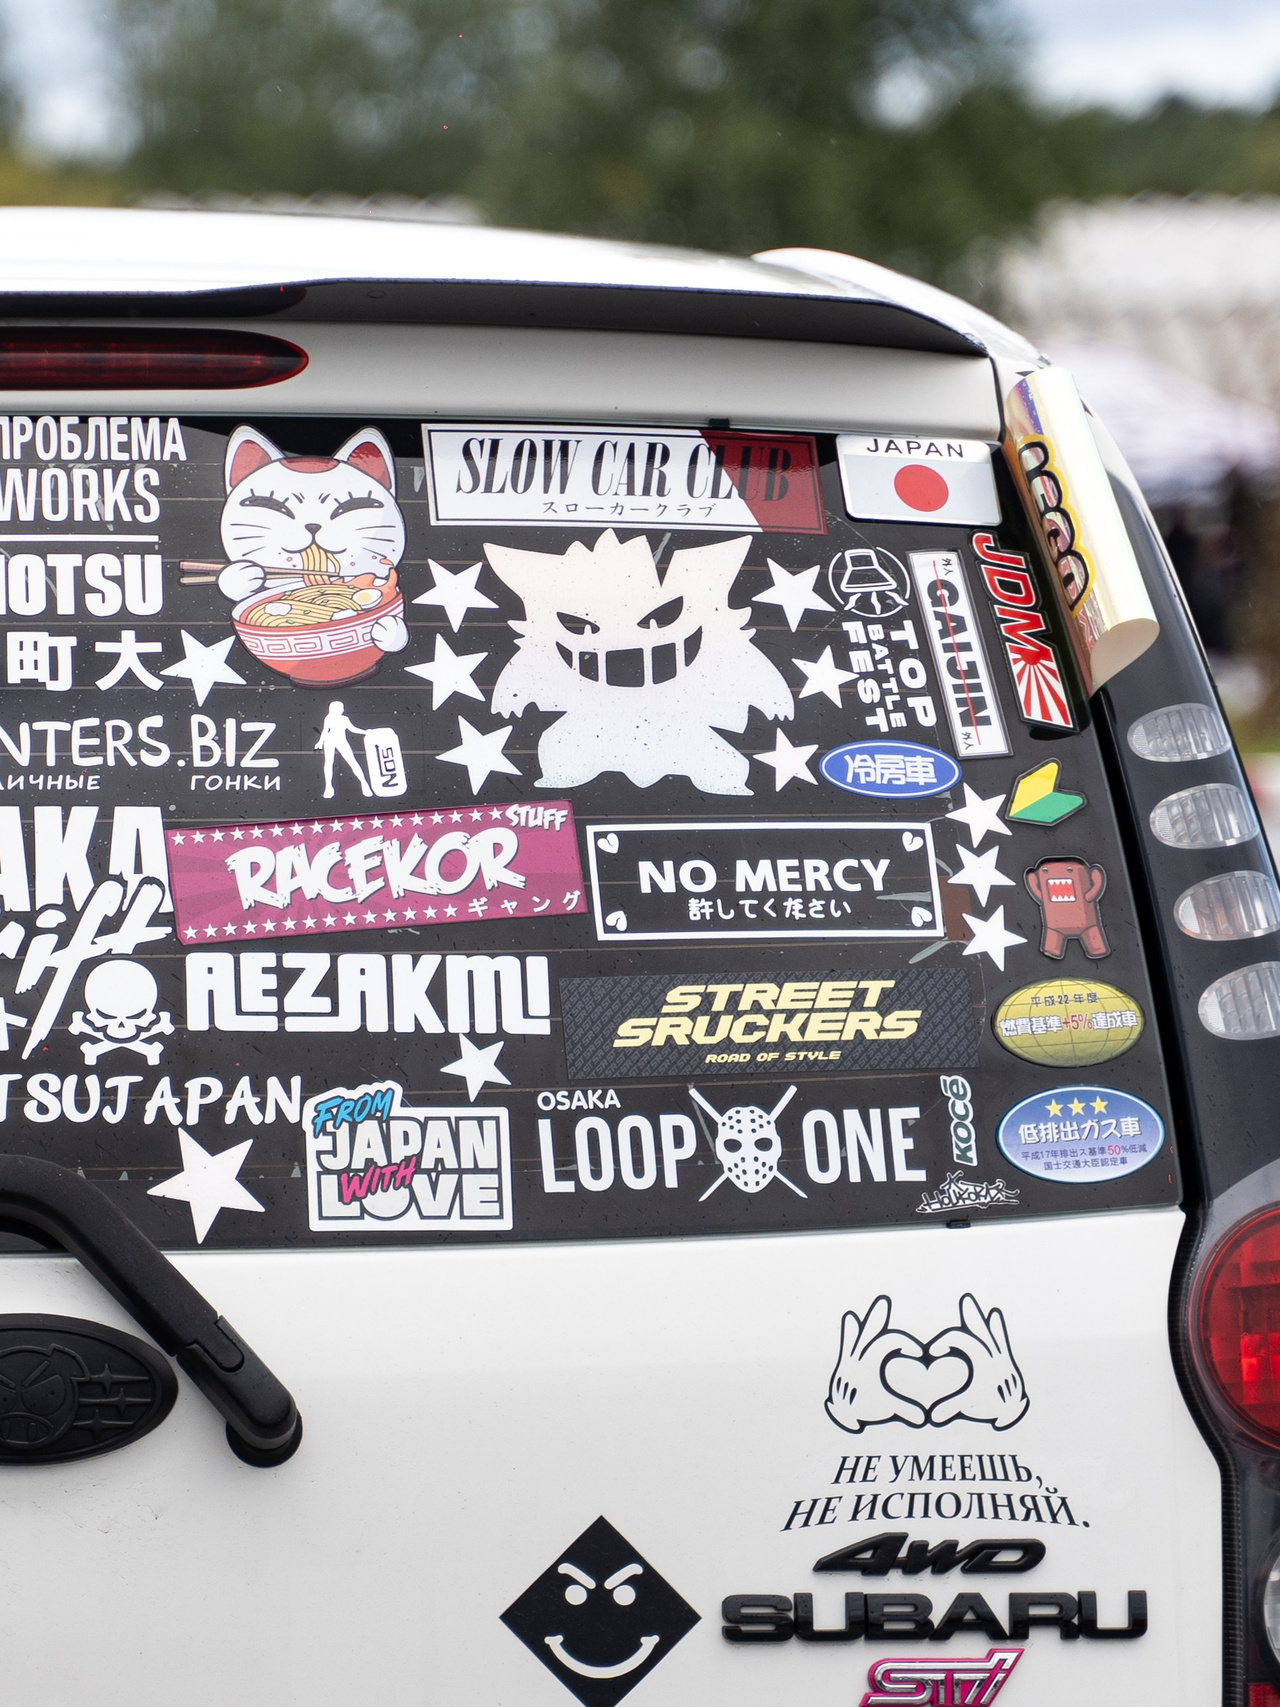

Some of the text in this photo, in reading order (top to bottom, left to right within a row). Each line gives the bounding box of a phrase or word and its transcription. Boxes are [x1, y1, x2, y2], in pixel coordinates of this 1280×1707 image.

[455, 437, 792, 501] SLOW CAR CLUB
[866, 438, 964, 458] JAPAN
[542, 500, 717, 518] スローカークラブ
[867, 624, 907, 728] BATTLE
[890, 620, 937, 727] TOP
[926, 579, 992, 728] GAIJIN
[842, 621, 889, 732] FEST
[190, 774, 281, 791] ГОНКИ
[843, 753, 937, 786] 冷房車
[505, 804, 569, 831] STUFF
[224, 827, 527, 911] RACEKOR
[637, 858, 891, 894] NO MERCY
[467, 890, 581, 917] ギャング
[660, 980, 896, 1013] STREET
[613, 1010, 923, 1048] SRUCKERS
[705, 1050, 842, 1064] ROAD OF STYLE
[312, 1089, 394, 1138] FROM
[536, 1089, 621, 1111] OSAKA
[319, 1117, 499, 1171] JAPAN
[538, 1106, 927, 1193] LOOP ONE
[1018, 1117, 1142, 1145] 低排出ガス車
[320, 1173, 501, 1218] LOVE
[340, 1156, 417, 1205] WITH
[831, 1453, 1043, 1490] НЕ УМЕЕШЬ,
[779, 1487, 1091, 1533] НЕ ИСПОЛНЯЙ.
[813, 1531, 1046, 1576] 4WD
[720, 1590, 1149, 1643] SUBARU
